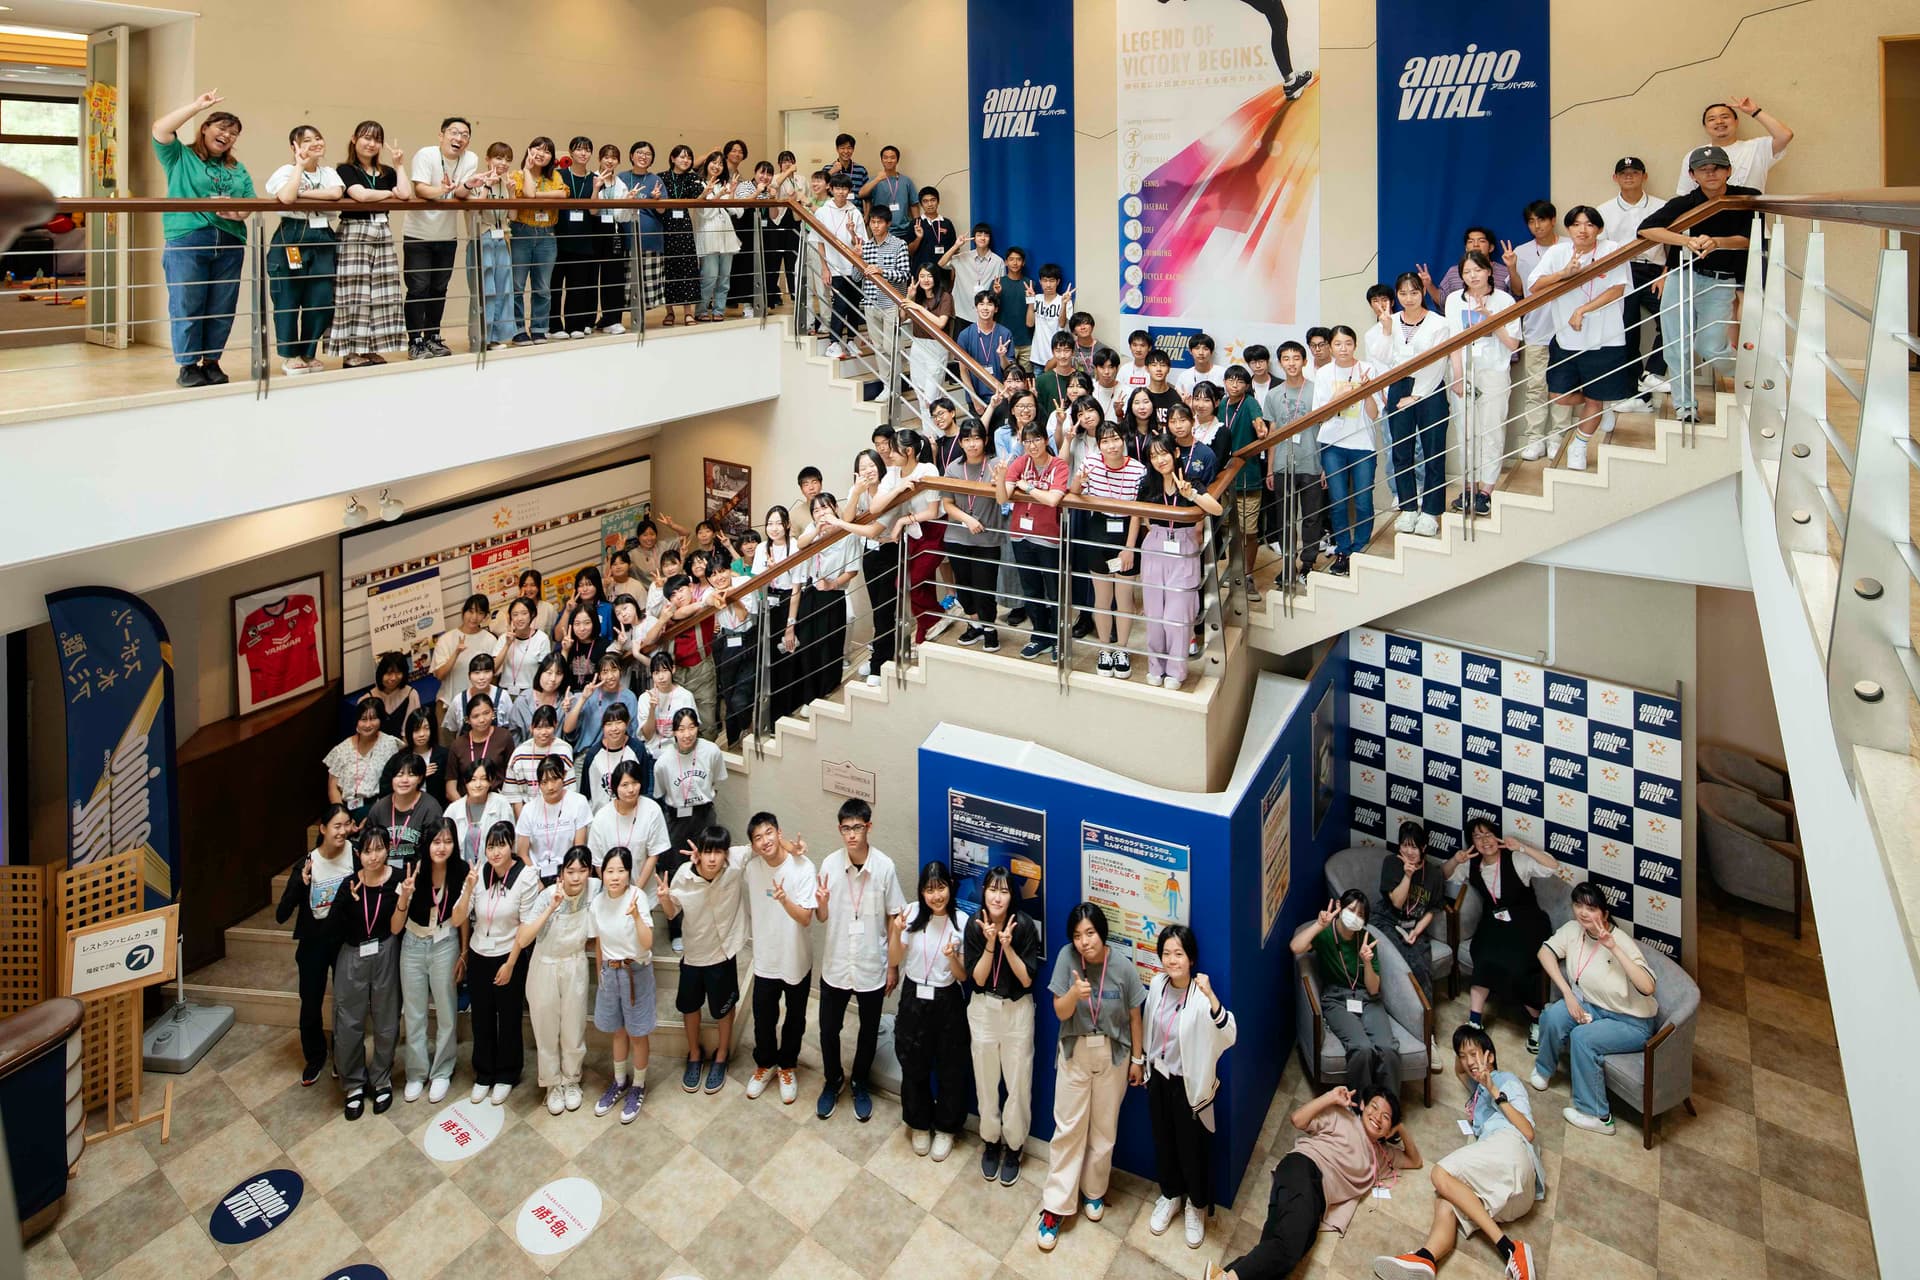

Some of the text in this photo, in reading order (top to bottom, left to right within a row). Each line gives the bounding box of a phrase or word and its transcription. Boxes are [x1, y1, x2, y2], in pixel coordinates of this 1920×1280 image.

[1121, 24, 1215, 53] LEGEND OF
[1123, 45, 1268, 77] VICTORY BEGINS.
[1398, 43, 1521, 89] amino
[1489, 80, 1537, 91] アミノバイタル
[983, 79, 1057, 114] amino
[1398, 84, 1487, 121] VITAL
[982, 110, 1037, 139] VITAL
[264, 636, 301, 656] YANMAR
[1390, 645, 1417, 658] amino
[1390, 652, 1411, 665] VITAL
[1354, 670, 1380, 684] amino
[1466, 662, 1496, 677] amino
[1466, 670, 1489, 684] VITAL
[1354, 678, 1375, 690] VITAL
[1549, 682, 1582, 699] amino
[1427, 689, 1456, 703] amino
[1427, 697, 1449, 710] VITAL
[1549, 691, 1574, 706] VITAL
[1507, 709, 1538, 725] amino
[1639, 703, 1674, 721] amino
[1390, 714, 1417, 727] amino
[1390, 721, 1411, 734] VITAL
[1507, 718, 1531, 732] VITAL
[1639, 713, 1666, 727] VITAL
[1354, 738, 1380, 753] amino
[1466, 734, 1496, 749] amino
[1593, 731, 1627, 747] amino
[1354, 746, 1375, 758] VITAL
[1466, 742, 1489, 756] VITAL
[1593, 740, 1619, 754] VITAL
[1427, 760, 1456, 774] amino
[1549, 757, 1582, 773] amino
[1427, 768, 1449, 781] VITAL
[1549, 766, 1574, 781] VITAL
[1390, 783, 1417, 797] amino
[1507, 782, 1538, 798] amino
[1639, 781, 1674, 798] amino
[1390, 791, 1411, 804] VITAL
[1507, 791, 1531, 805] VITAL
[1639, 791, 1666, 805] VITAL
[1593, 807, 1627, 824] amino
[1593, 817, 1619, 831] VITAL
[1549, 832, 1582, 848] amino
[1549, 841, 1574, 855] VITAL
[1639, 859, 1674, 877] amino
[1639, 869, 1666, 883] VITAL
[82, 932, 141, 953] レストラン・ヒムカ
[245, 1178, 290, 1218] amino
[223, 1190, 263, 1226] VITAL
